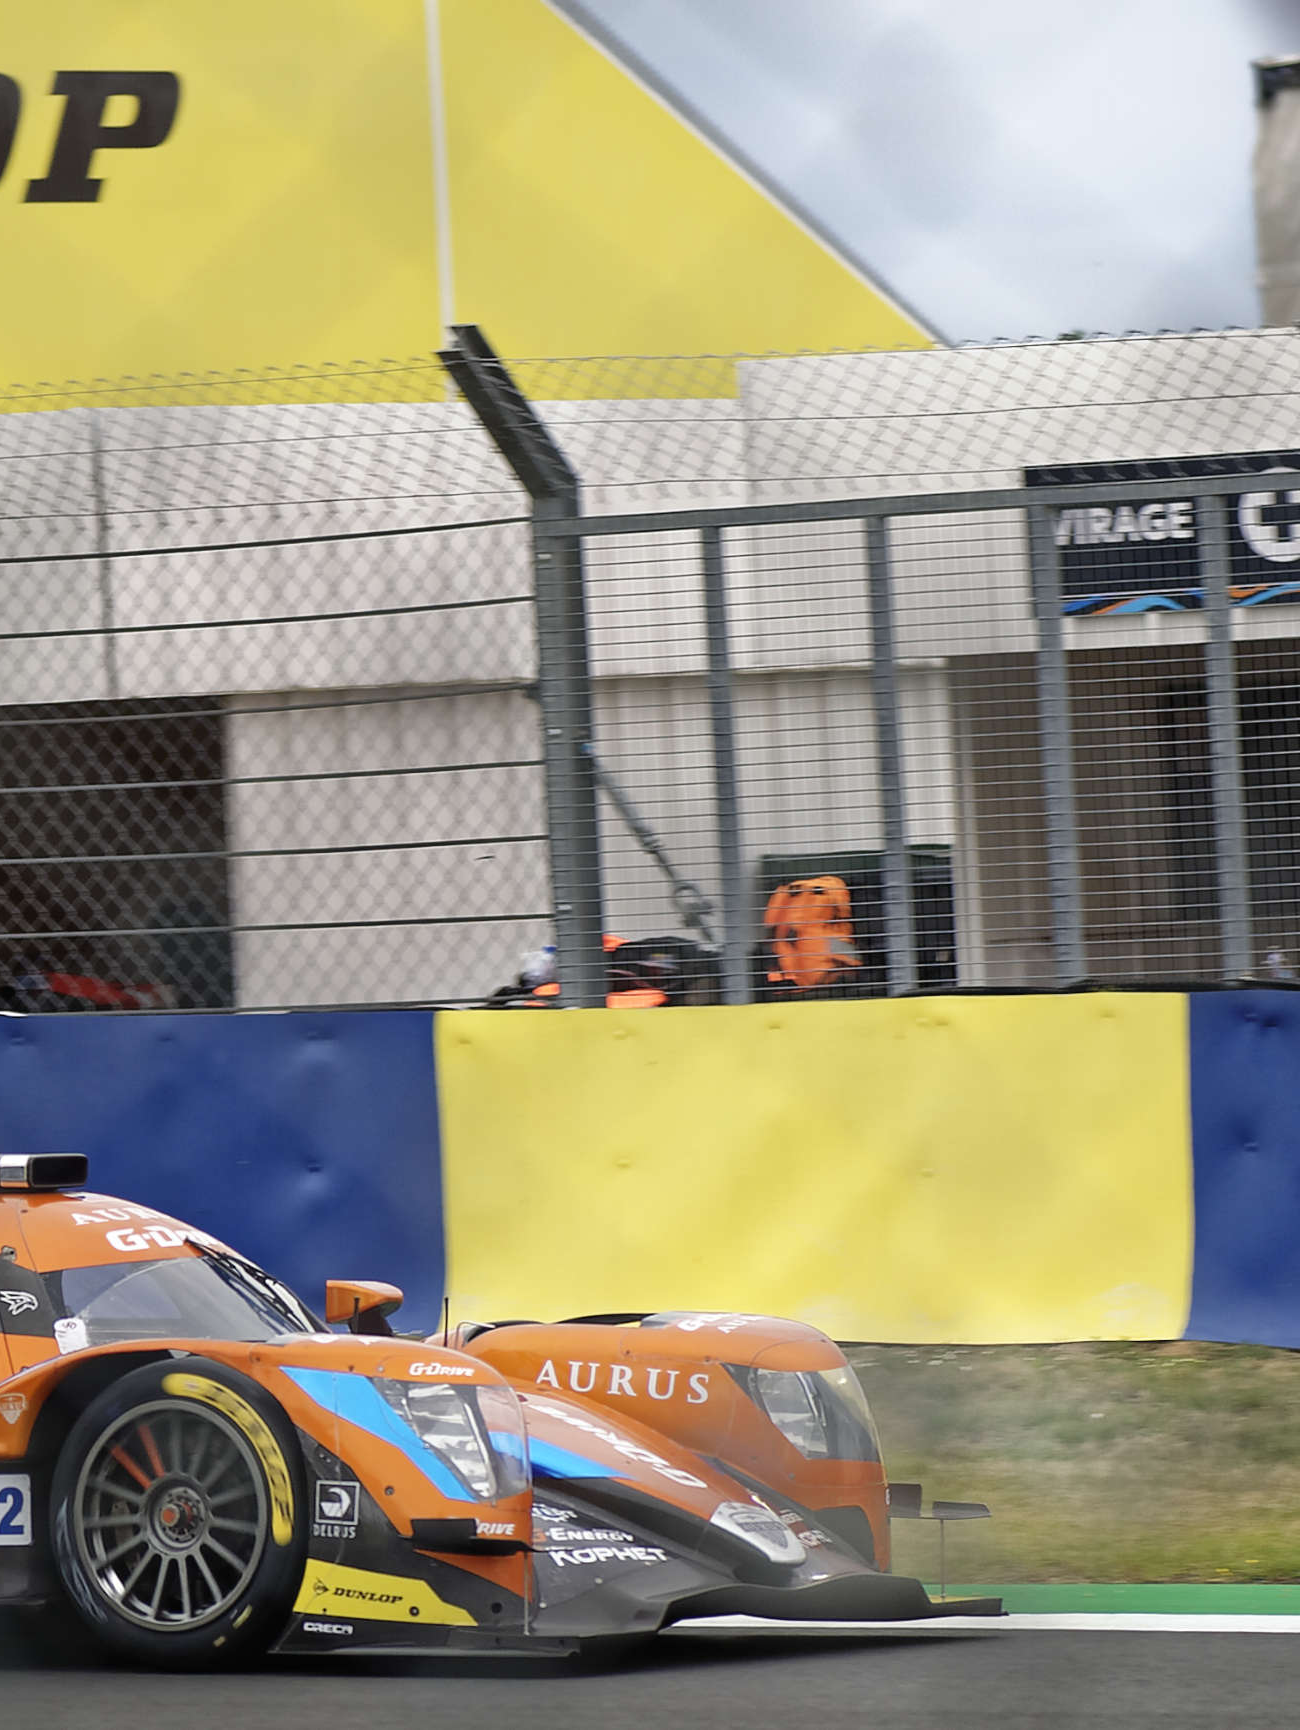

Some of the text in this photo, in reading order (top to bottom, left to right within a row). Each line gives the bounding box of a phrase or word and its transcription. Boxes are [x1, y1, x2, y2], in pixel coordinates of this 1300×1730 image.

[408, 1362, 475, 1377] G-DRIVE
[535, 1358, 710, 1404] AURUS
[332, 1586, 403, 1605] DUNLOP
